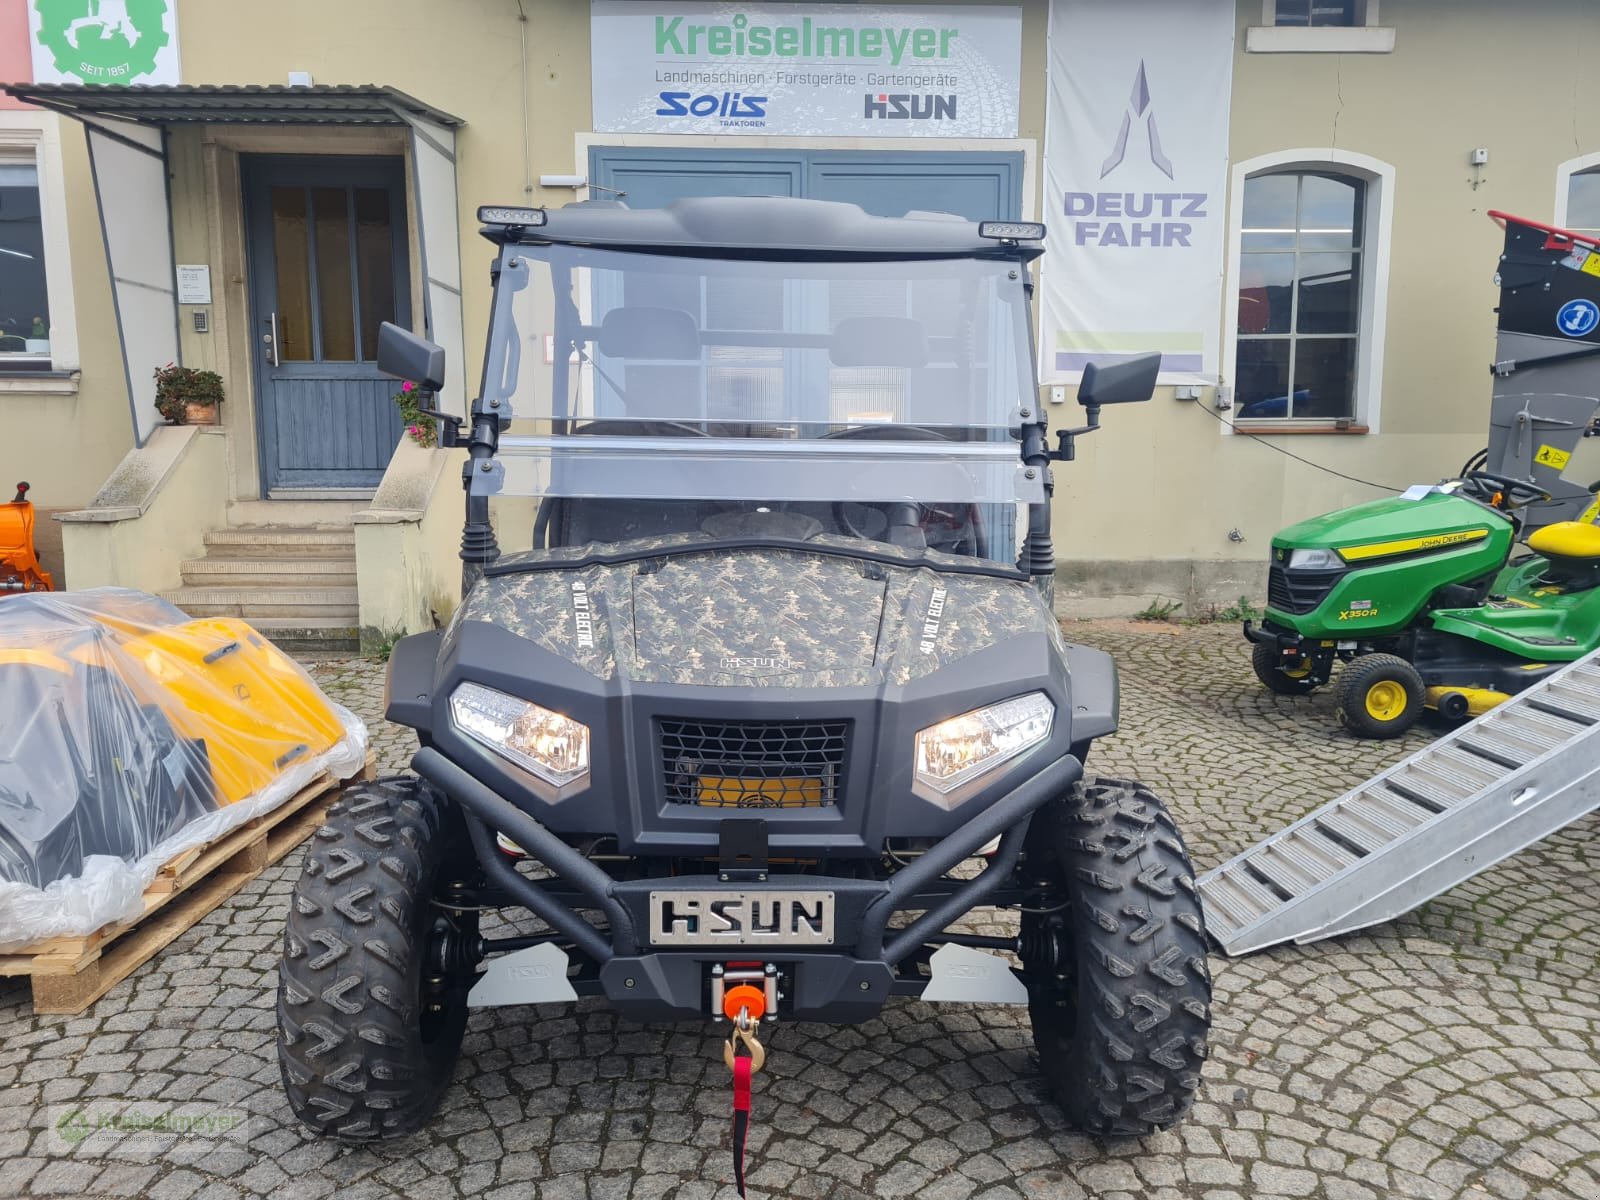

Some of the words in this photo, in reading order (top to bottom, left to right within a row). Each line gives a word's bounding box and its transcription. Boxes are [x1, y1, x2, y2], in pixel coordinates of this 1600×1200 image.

[655, 14, 959, 66] Kreiselmeyer
[79, 62, 104, 77] SEIT
[107, 62, 130, 77] 1857
[655, 70, 765, 84] Landmaschinen
[776, 71, 856, 87] Forstgeräte
[867, 72, 957, 88] Gartengeräte
[719, 120, 766, 128] TRAKTOREN
[1063, 191, 1208, 218] DEUTZ
[1075, 221, 1192, 247] FAHR
[1419, 538, 1441, 550] JOHN
[1442, 533, 1469, 545] DEERE
[572, 592, 589, 610] VOLT
[574, 612, 594, 649] ELECTRIC
[922, 617, 940, 638] VOLT
[919, 640, 936, 655] 48
